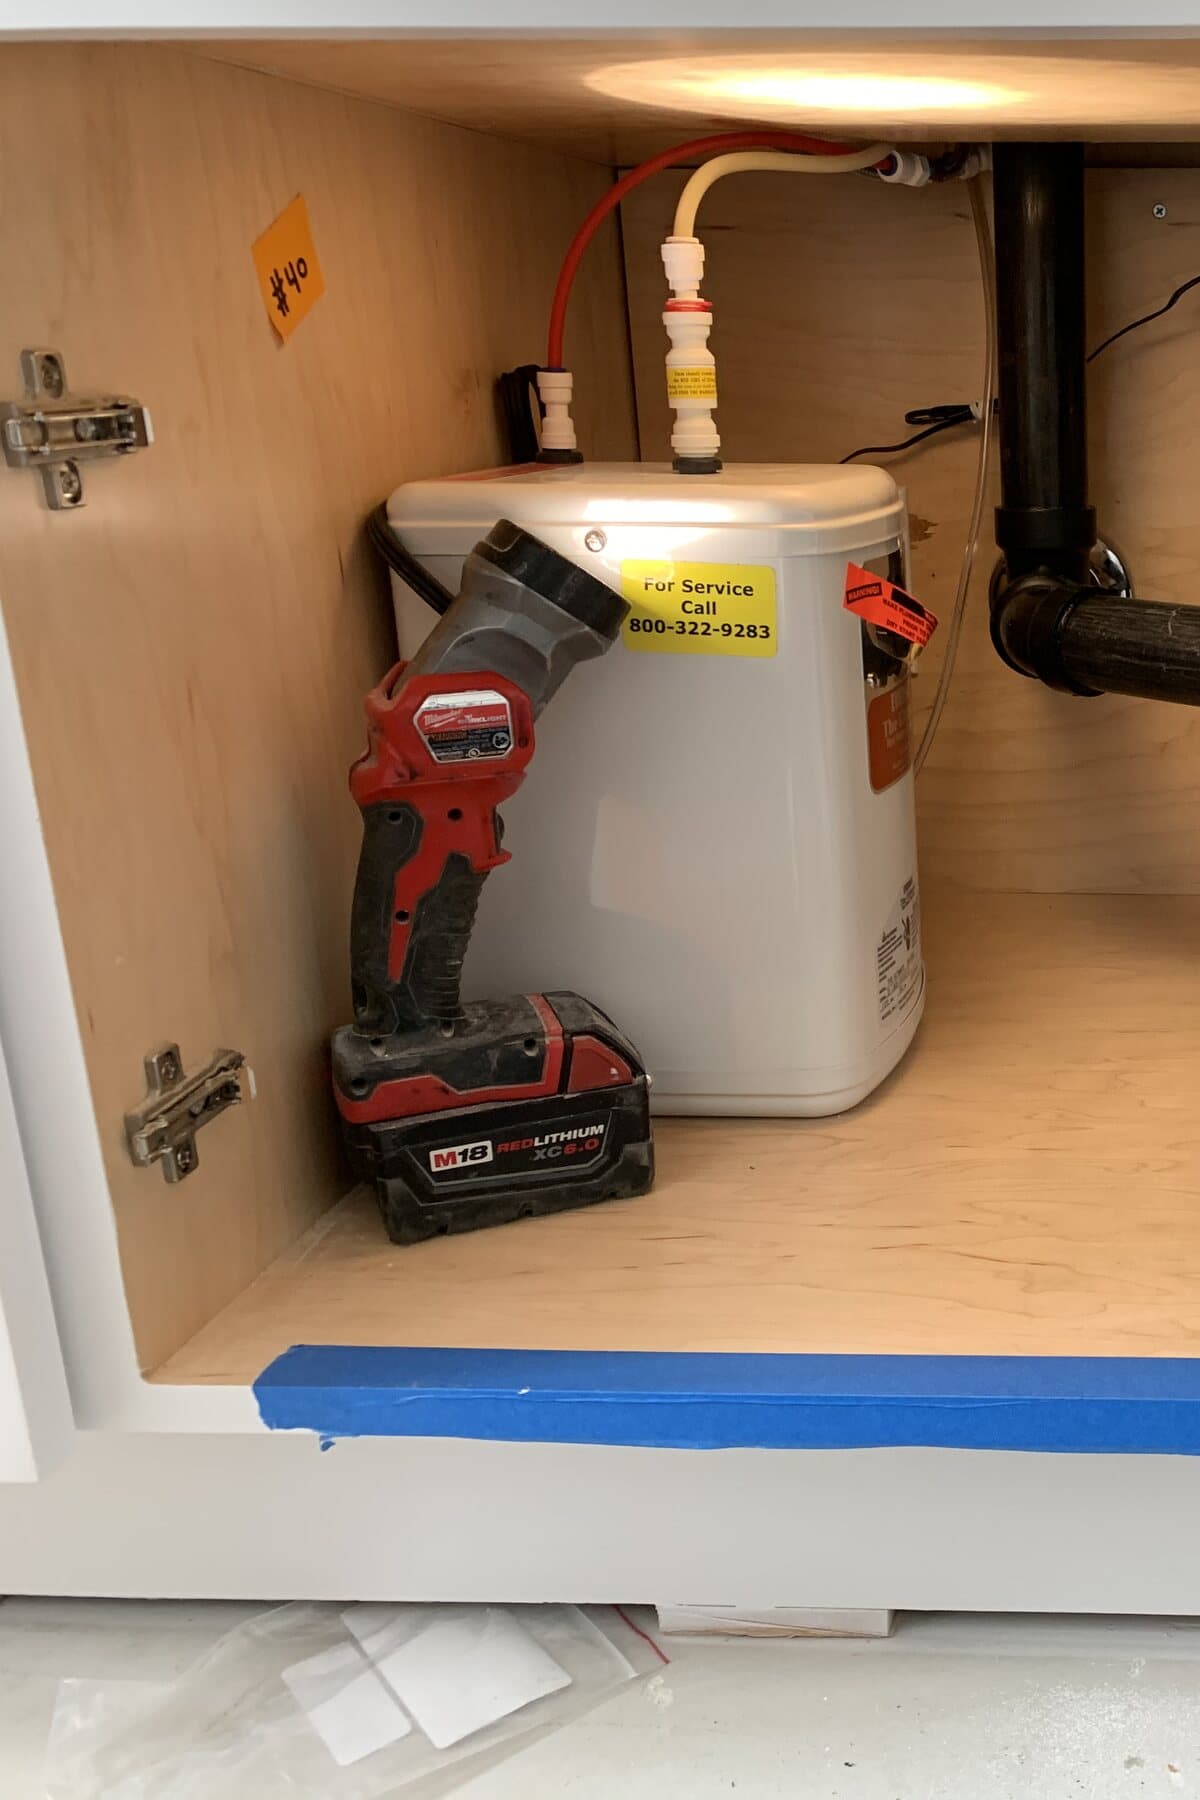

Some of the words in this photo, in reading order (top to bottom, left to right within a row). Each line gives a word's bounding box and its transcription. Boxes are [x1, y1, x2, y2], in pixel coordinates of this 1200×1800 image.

[270, 257, 308, 317] #40
[644, 577, 675, 592] For
[682, 579, 754, 596] Service
[681, 600, 717, 615] Call
[629, 618, 771, 639] 800-322-9283
[497, 1124, 604, 1153] REDLITHIUM
[532, 1138, 599, 1161] XC6.0
[434, 1145, 488, 1168] M18
